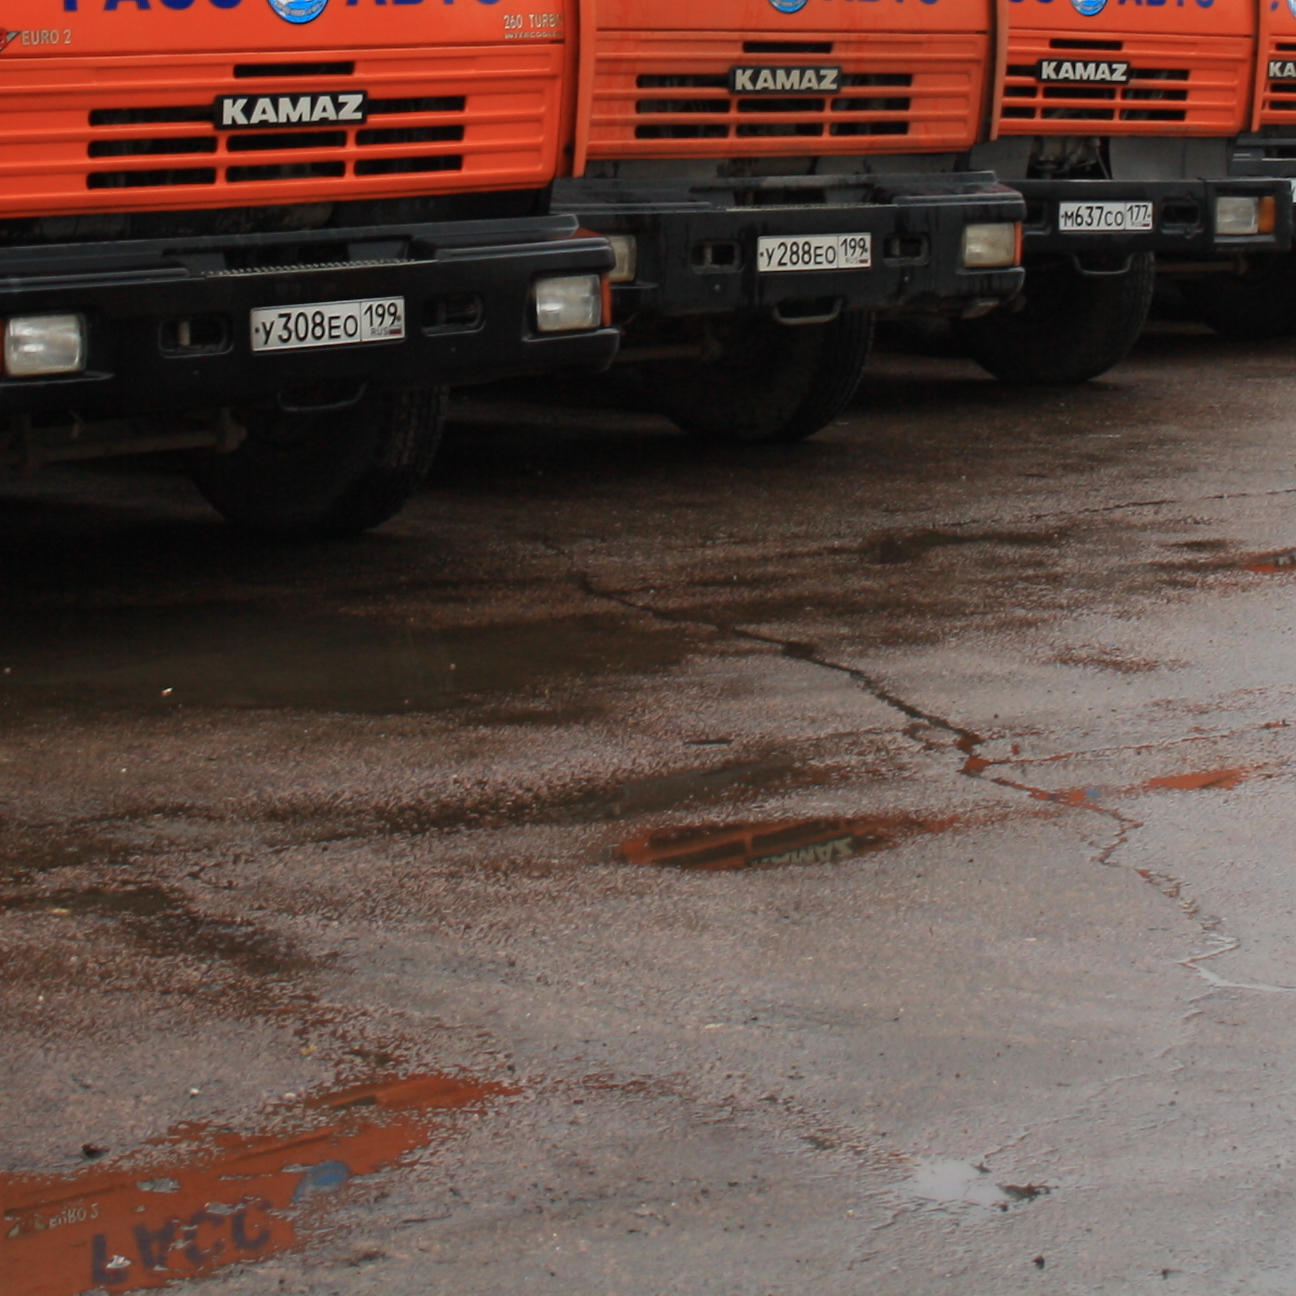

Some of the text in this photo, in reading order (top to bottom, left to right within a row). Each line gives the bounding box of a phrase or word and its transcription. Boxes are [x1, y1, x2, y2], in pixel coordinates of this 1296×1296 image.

[21, 29, 72, 45] EURO 2
[735, 69, 839, 90] KAMAZ
[1041, 61, 1128, 81] KAMAZ
[222, 94, 364, 125] KAMAZ
[1064, 206, 1124, 227] М637СО
[765, 238, 866, 267] У288ЕО 199
[261, 302, 399, 345] У308ЕО 199
